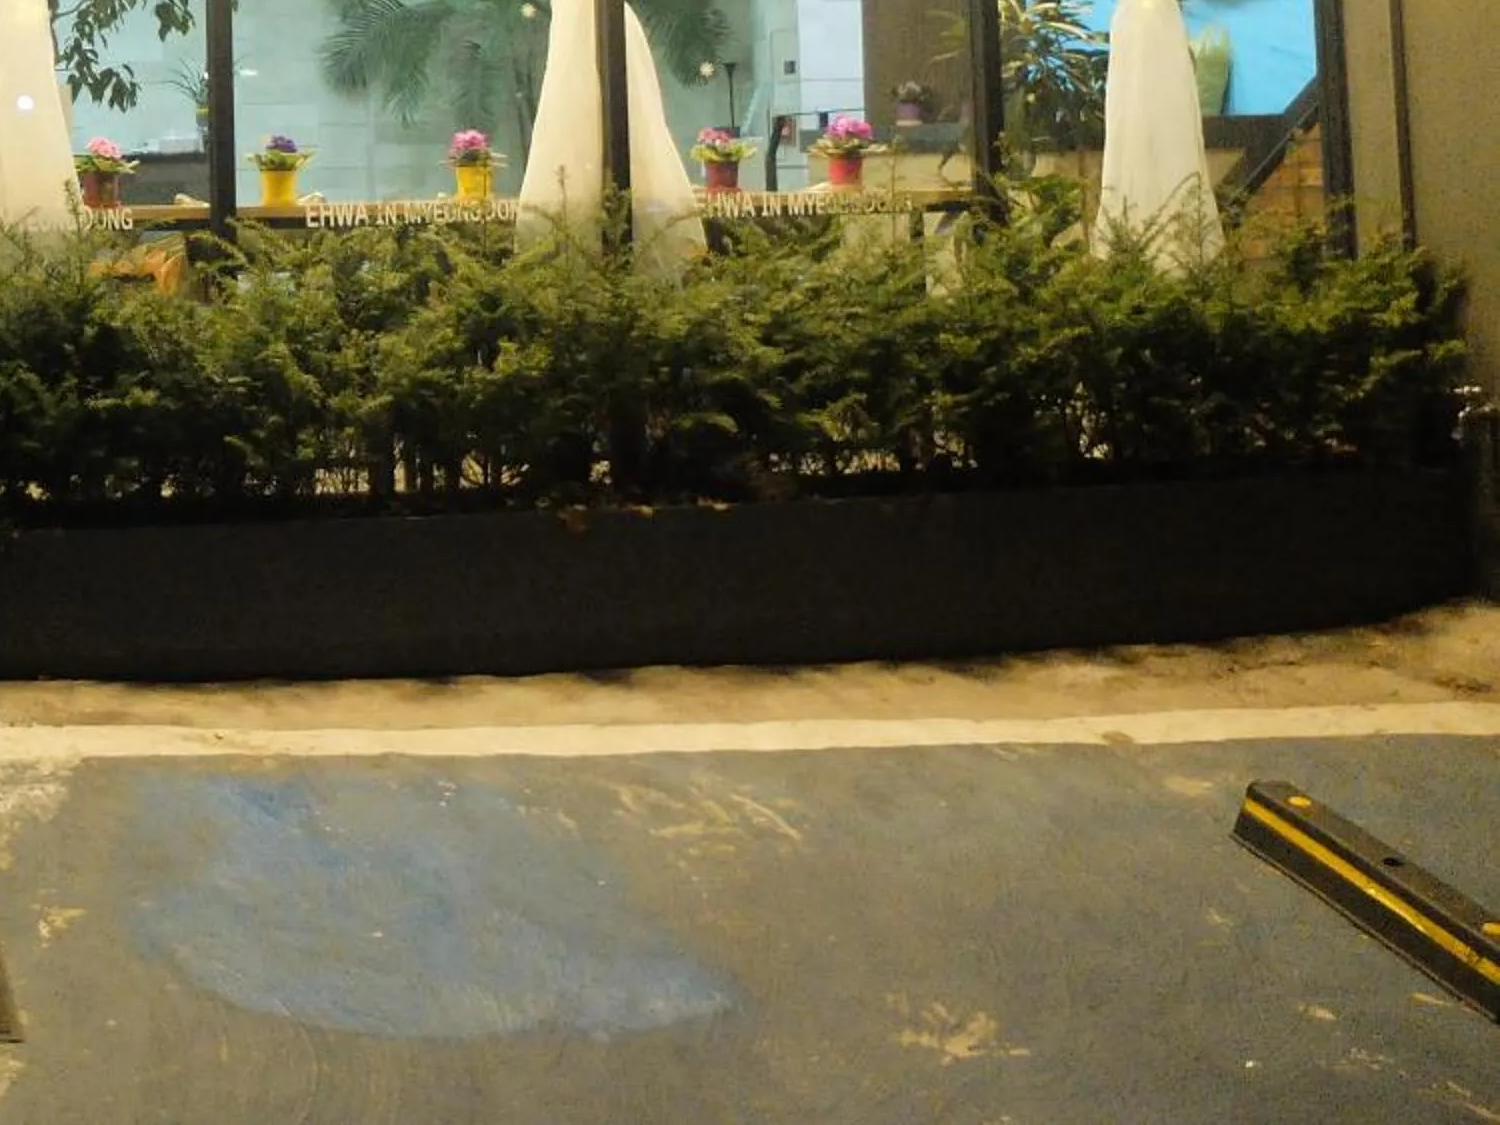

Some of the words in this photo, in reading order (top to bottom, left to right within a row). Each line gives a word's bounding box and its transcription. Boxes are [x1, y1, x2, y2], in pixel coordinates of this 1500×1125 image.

[305, 203, 369, 228] EHWA
[376, 204, 397, 225] IN
[762, 191, 782, 217] IN
